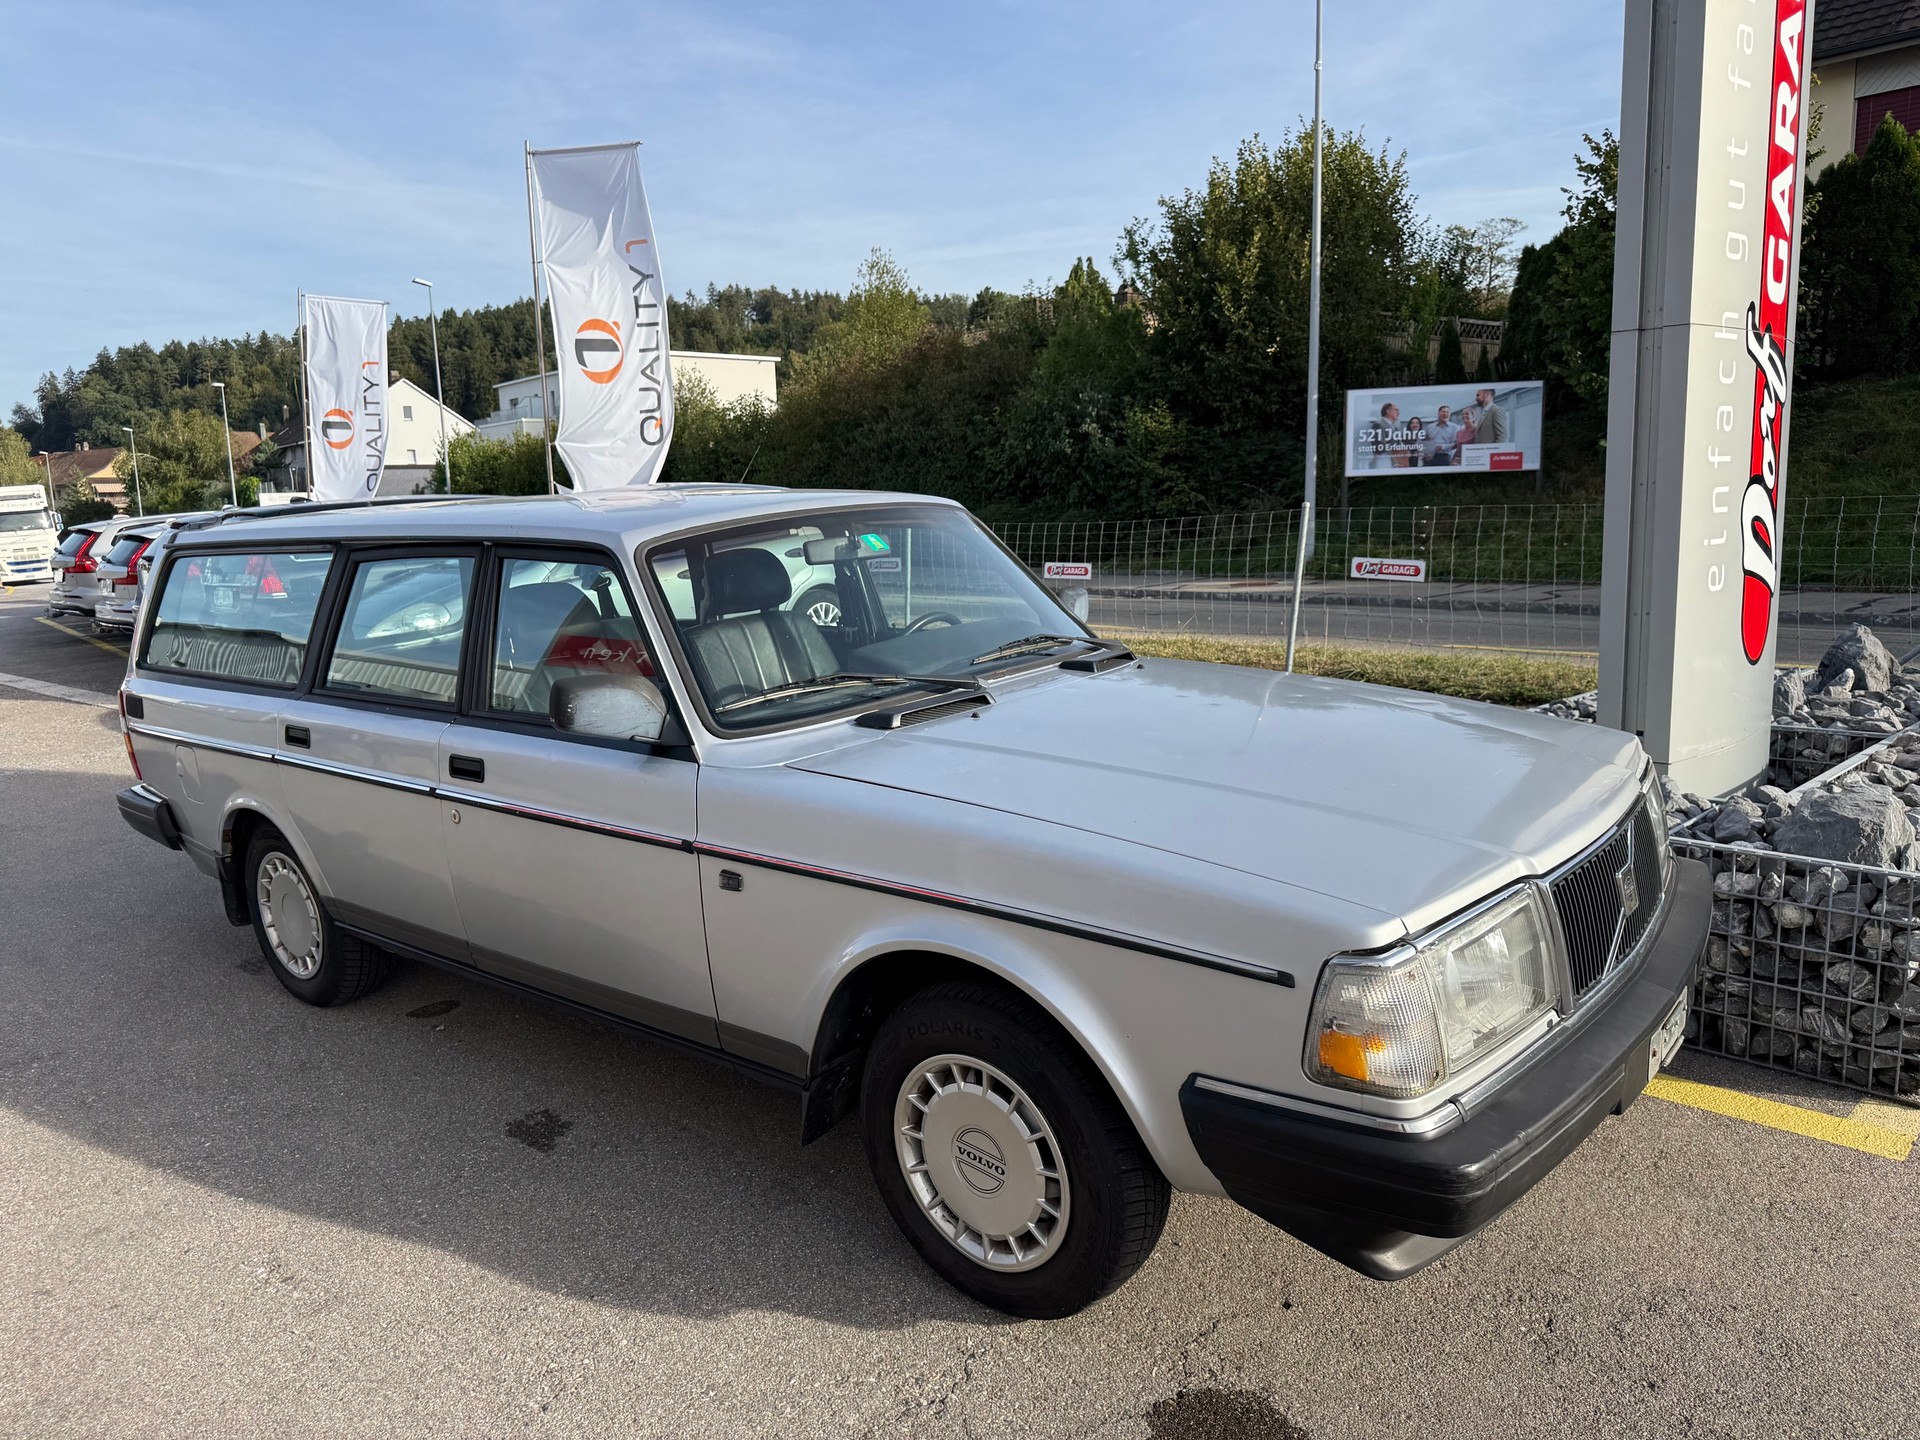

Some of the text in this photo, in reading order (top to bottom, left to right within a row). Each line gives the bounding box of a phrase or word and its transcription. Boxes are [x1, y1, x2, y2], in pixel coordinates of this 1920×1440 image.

[1704, 0, 1756, 593] einfach gut fa
[1741, 0, 1803, 597] Dorf GARA
[1358, 427, 1426, 443] 521 Jahre
[1358, 444, 1376, 453] statt
[1385, 442, 1426, 452] Erfahrung.
[1064, 567, 1086, 575] GARAGE
[1382, 564, 1416, 575] GARAGE
[907, 1021, 984, 1041] POLARIS
[956, 1145, 1006, 1177] VOLVO
